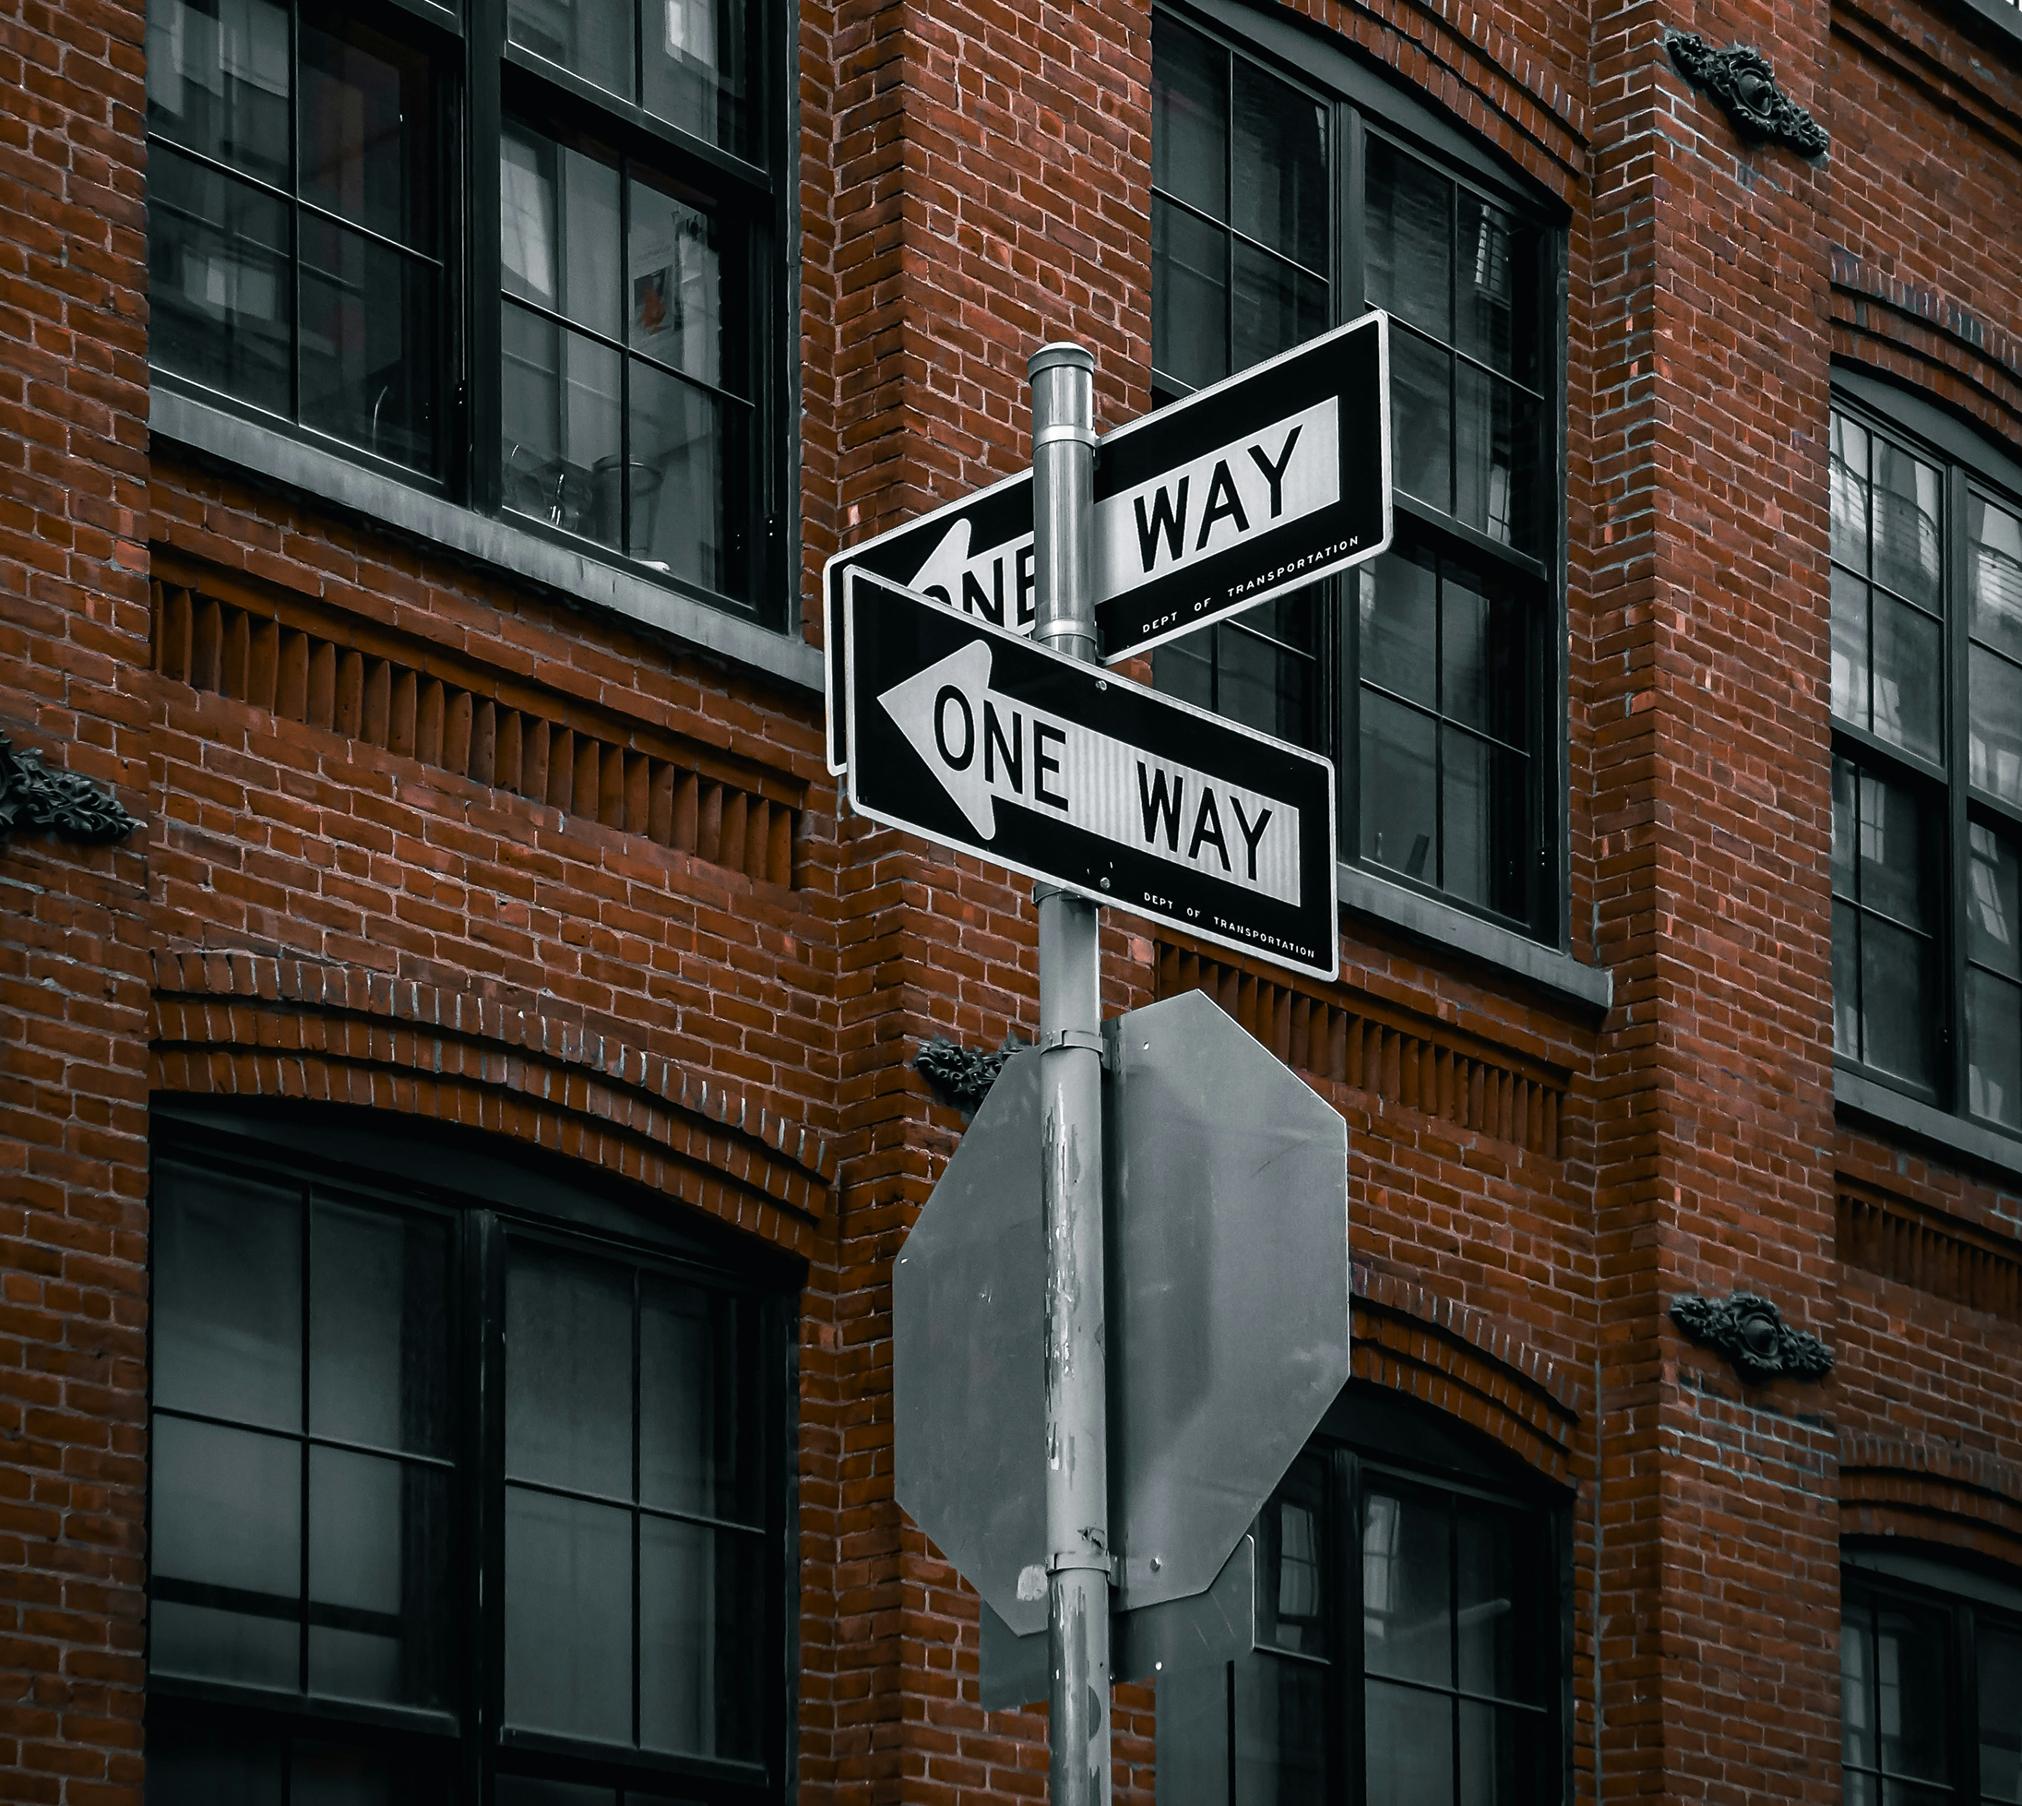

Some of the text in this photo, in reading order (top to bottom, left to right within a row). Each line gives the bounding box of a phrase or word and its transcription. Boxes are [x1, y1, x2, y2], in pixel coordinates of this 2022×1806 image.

[921, 424, 1303, 628] NE WAY
[1142, 536, 1359, 633] DEPT OF TRANSPORTATION
[933, 684, 1273, 881] ONE WAY
[1144, 892, 1315, 958] DEPT OF TRANSPORTATION
